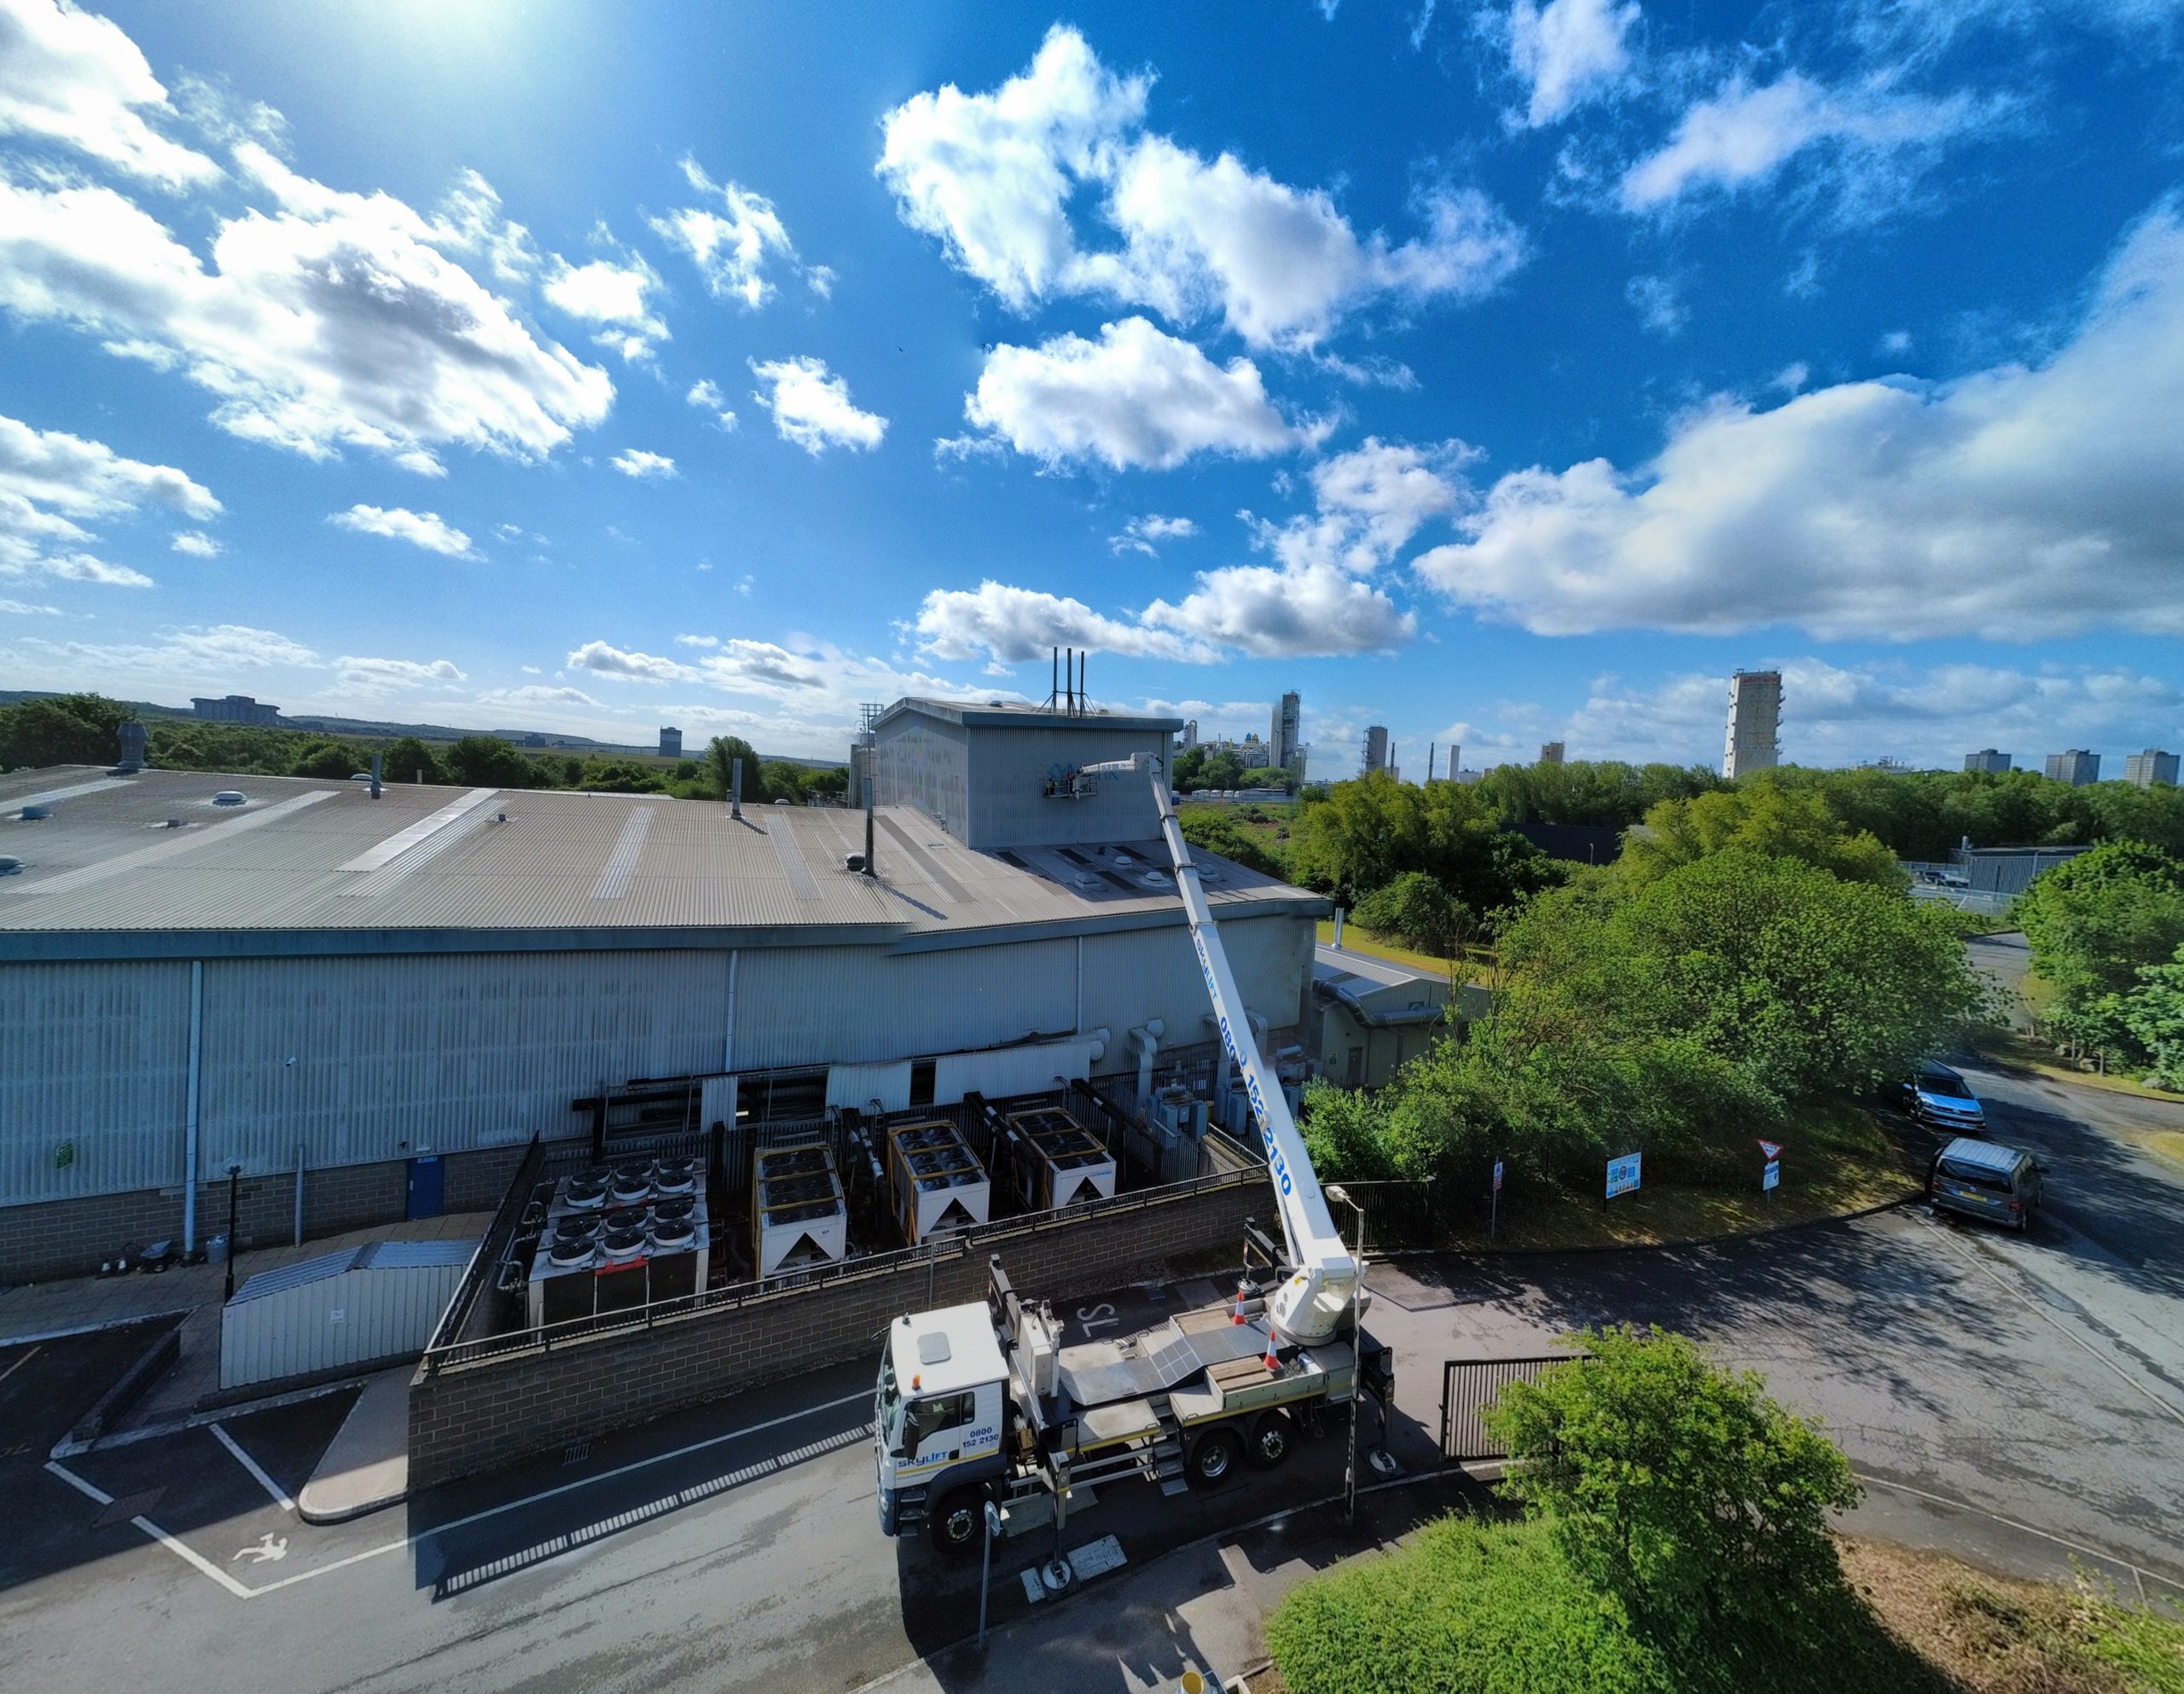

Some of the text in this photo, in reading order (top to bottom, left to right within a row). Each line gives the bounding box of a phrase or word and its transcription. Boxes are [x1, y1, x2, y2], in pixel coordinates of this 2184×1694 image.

[1246, 1073, 1265, 1120] 152
[1263, 1127, 1292, 1196] 2130
[1077, 1303, 1119, 1337] SL
[962, 1433, 999, 1448] 152 2130
[970, 1426, 992, 1438] 0800
